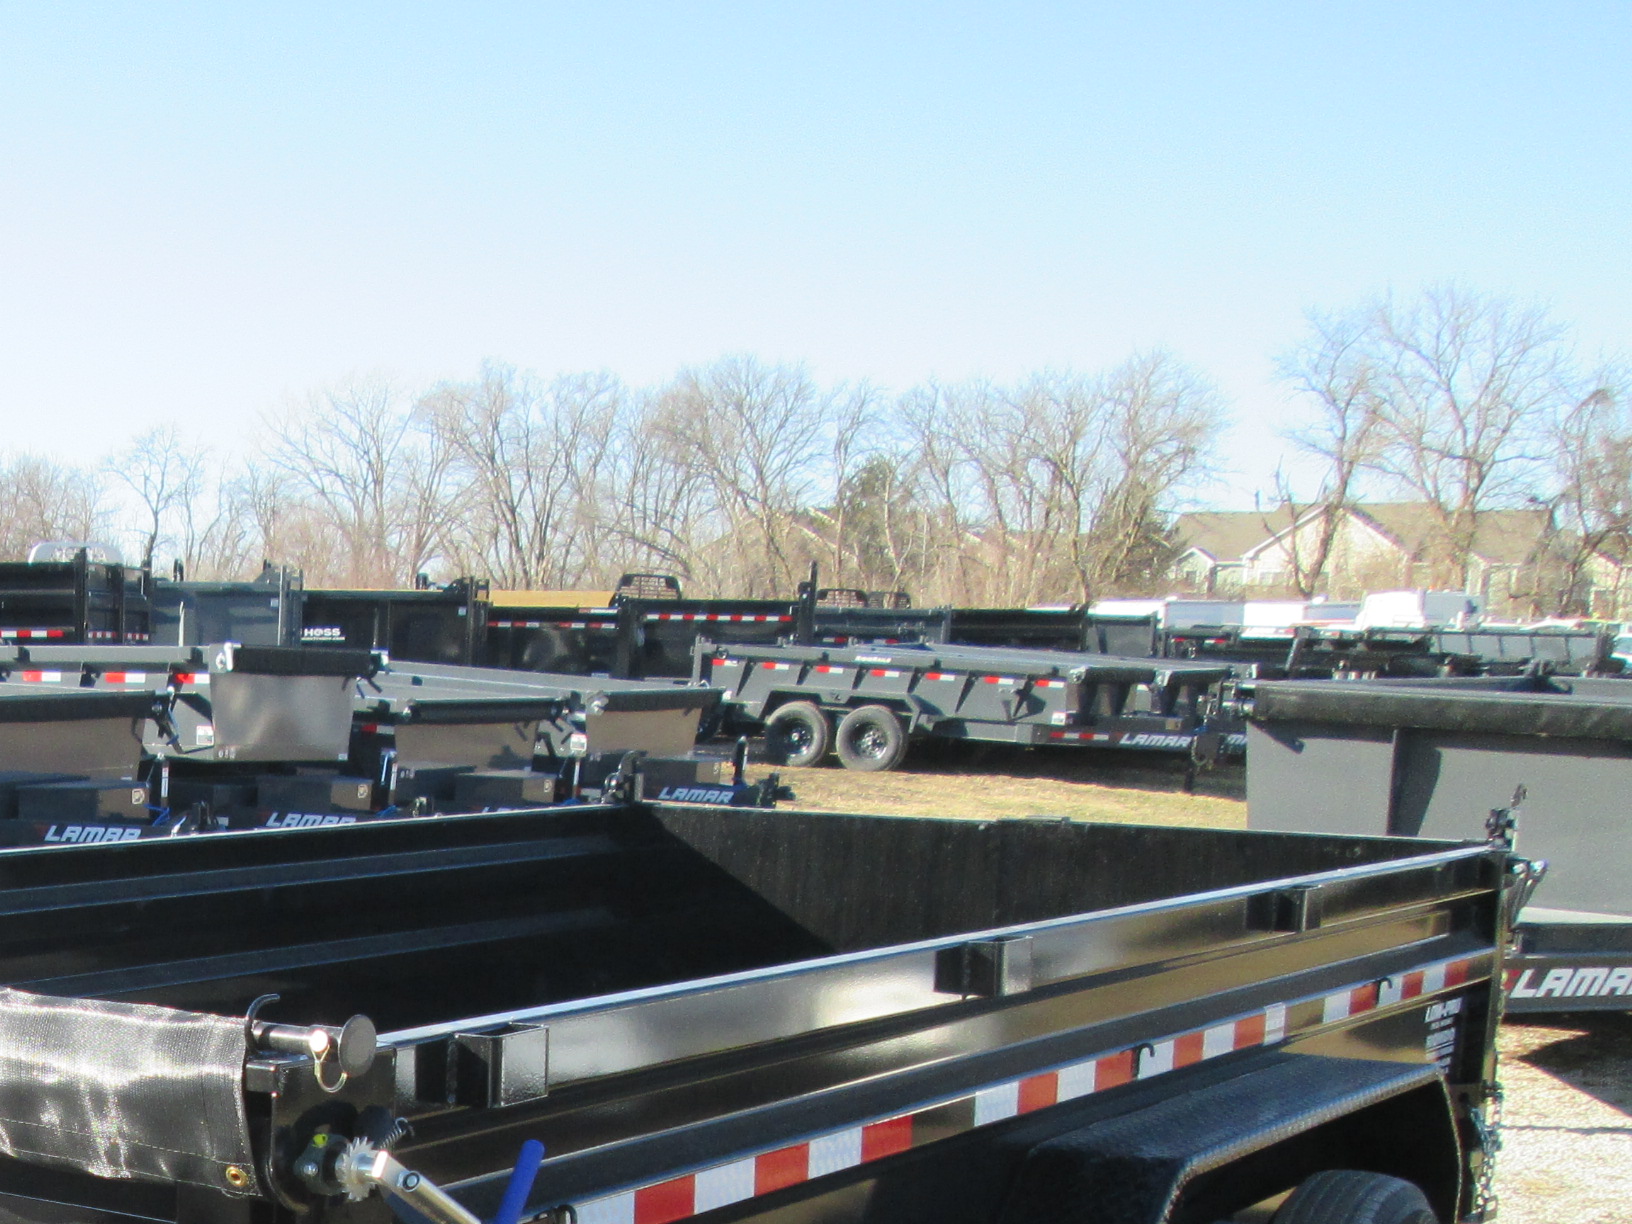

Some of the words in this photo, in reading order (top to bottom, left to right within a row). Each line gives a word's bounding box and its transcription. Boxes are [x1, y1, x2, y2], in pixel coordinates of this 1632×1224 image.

[304, 628, 341, 637] HOSS
[1119, 733, 1192, 747] LAMAR
[658, 787, 734, 803] LAMAR
[1509, 967, 1632, 998] LAMA
